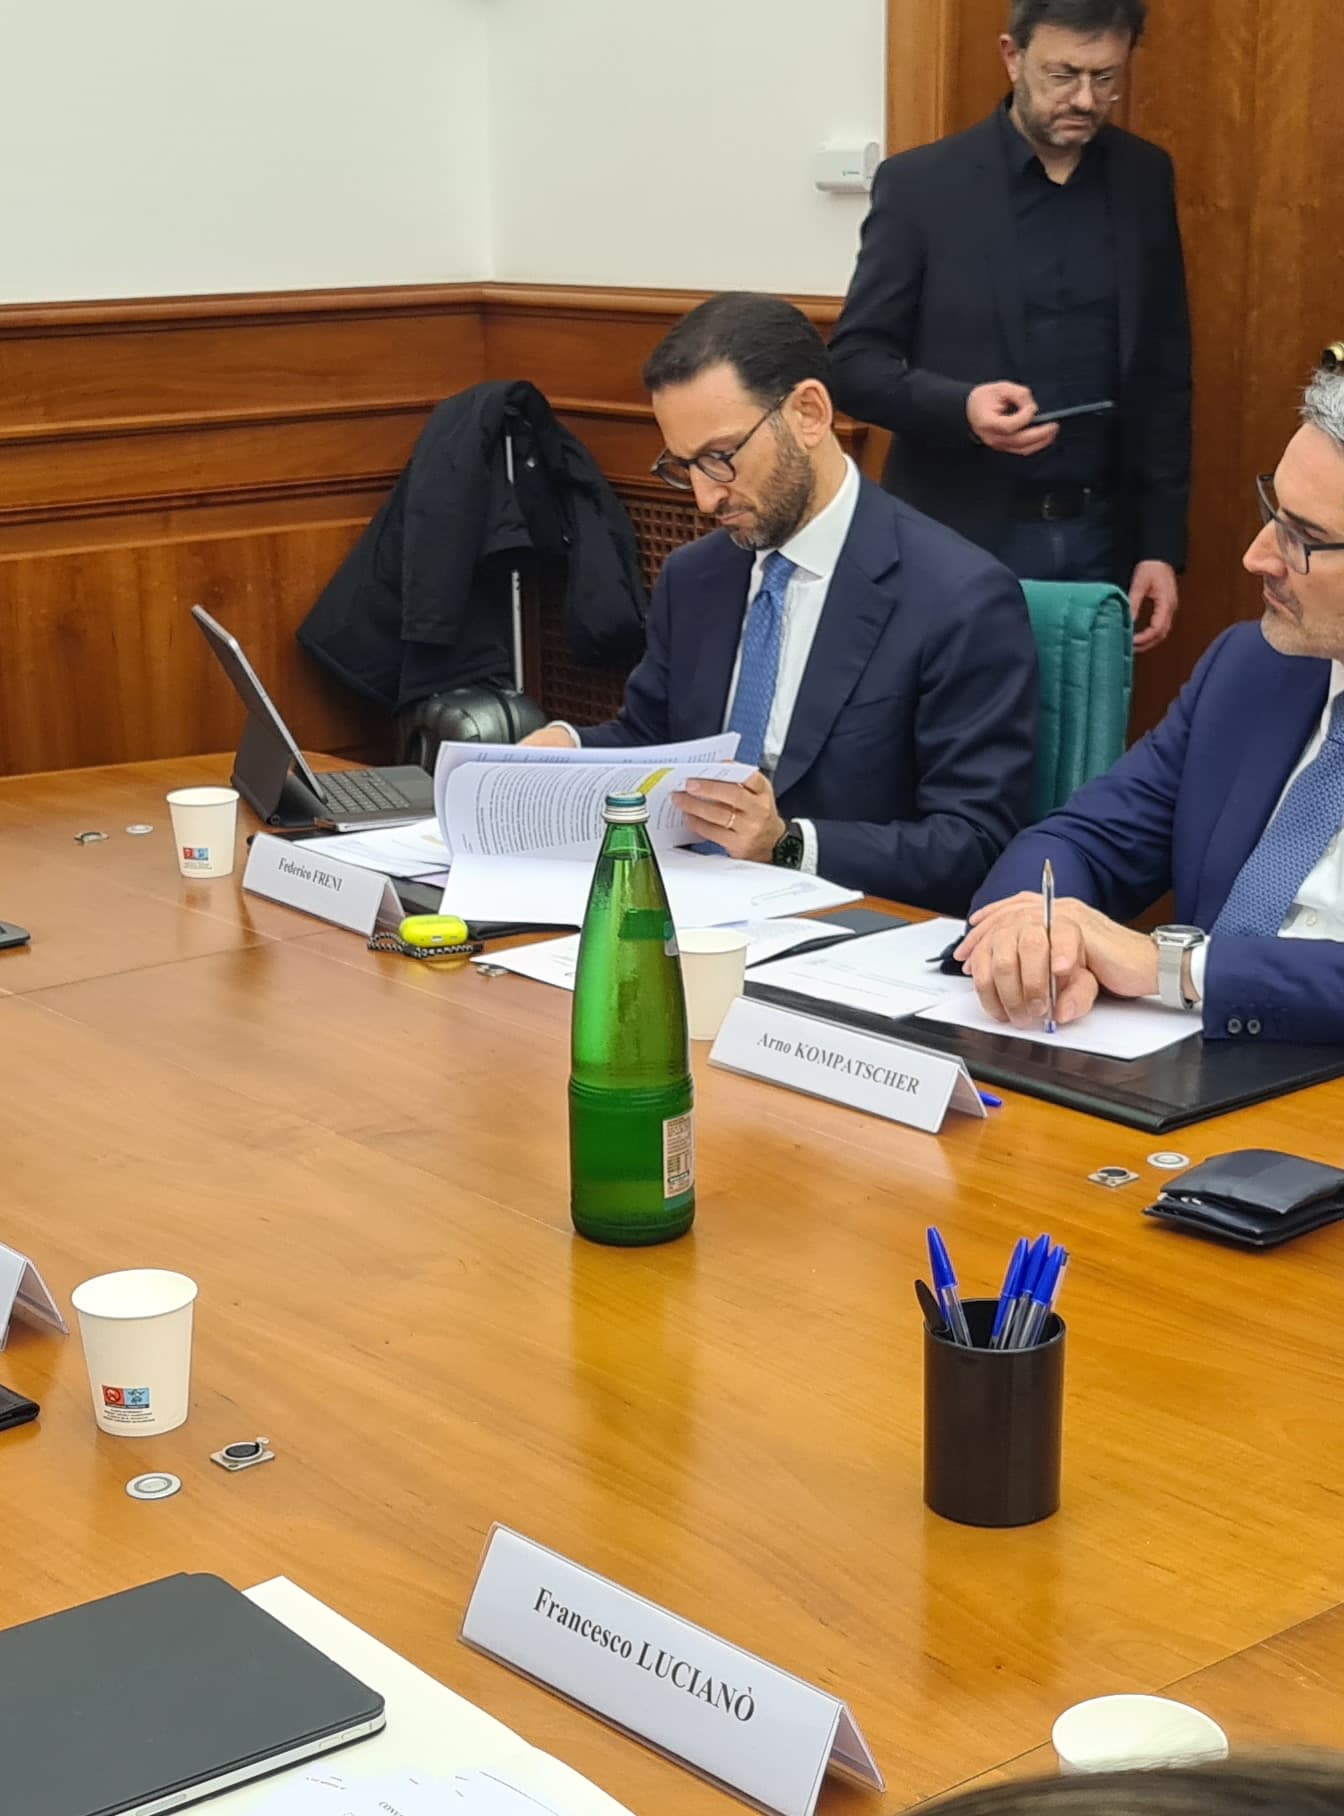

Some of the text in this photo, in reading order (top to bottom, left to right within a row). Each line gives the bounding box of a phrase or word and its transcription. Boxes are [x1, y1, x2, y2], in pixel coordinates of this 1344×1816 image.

[278, 857, 344, 892] Federico FRENI
[757, 1032, 920, 1095] Arno KOMPATSCHER
[532, 1587, 756, 1722] Francesco LUCIANÒ
